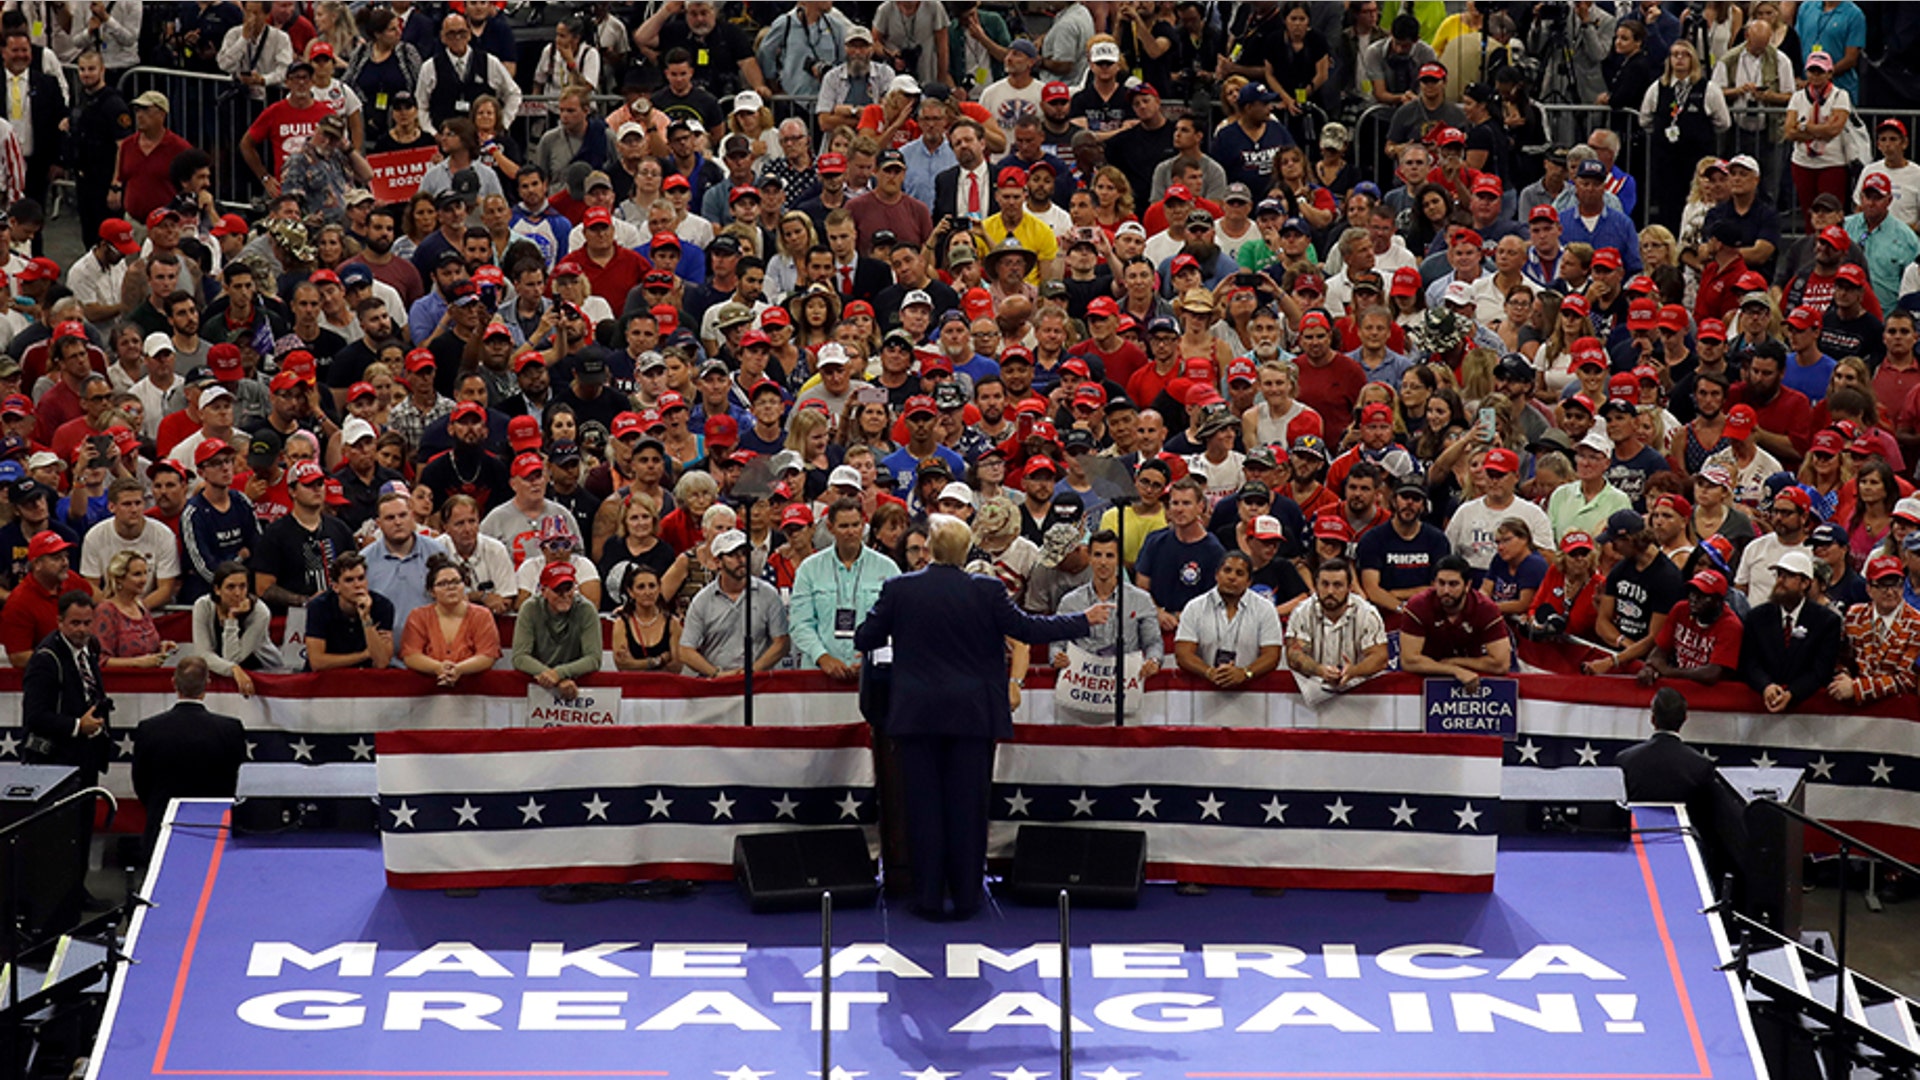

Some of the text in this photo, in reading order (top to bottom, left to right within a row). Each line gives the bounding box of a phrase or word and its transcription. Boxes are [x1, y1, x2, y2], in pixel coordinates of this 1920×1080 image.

[279, 122, 319, 137] BUIL
[1062, 669, 1139, 692] AMERIA
[531, 707, 614, 725] AMERICA
[1429, 701, 1513, 717] AMERICA
[1442, 717, 1501, 732] GREAT!
[246, 942, 1627, 980] MAKE AMERICA
[236, 989, 1645, 1033] GREAT AGAIN!
